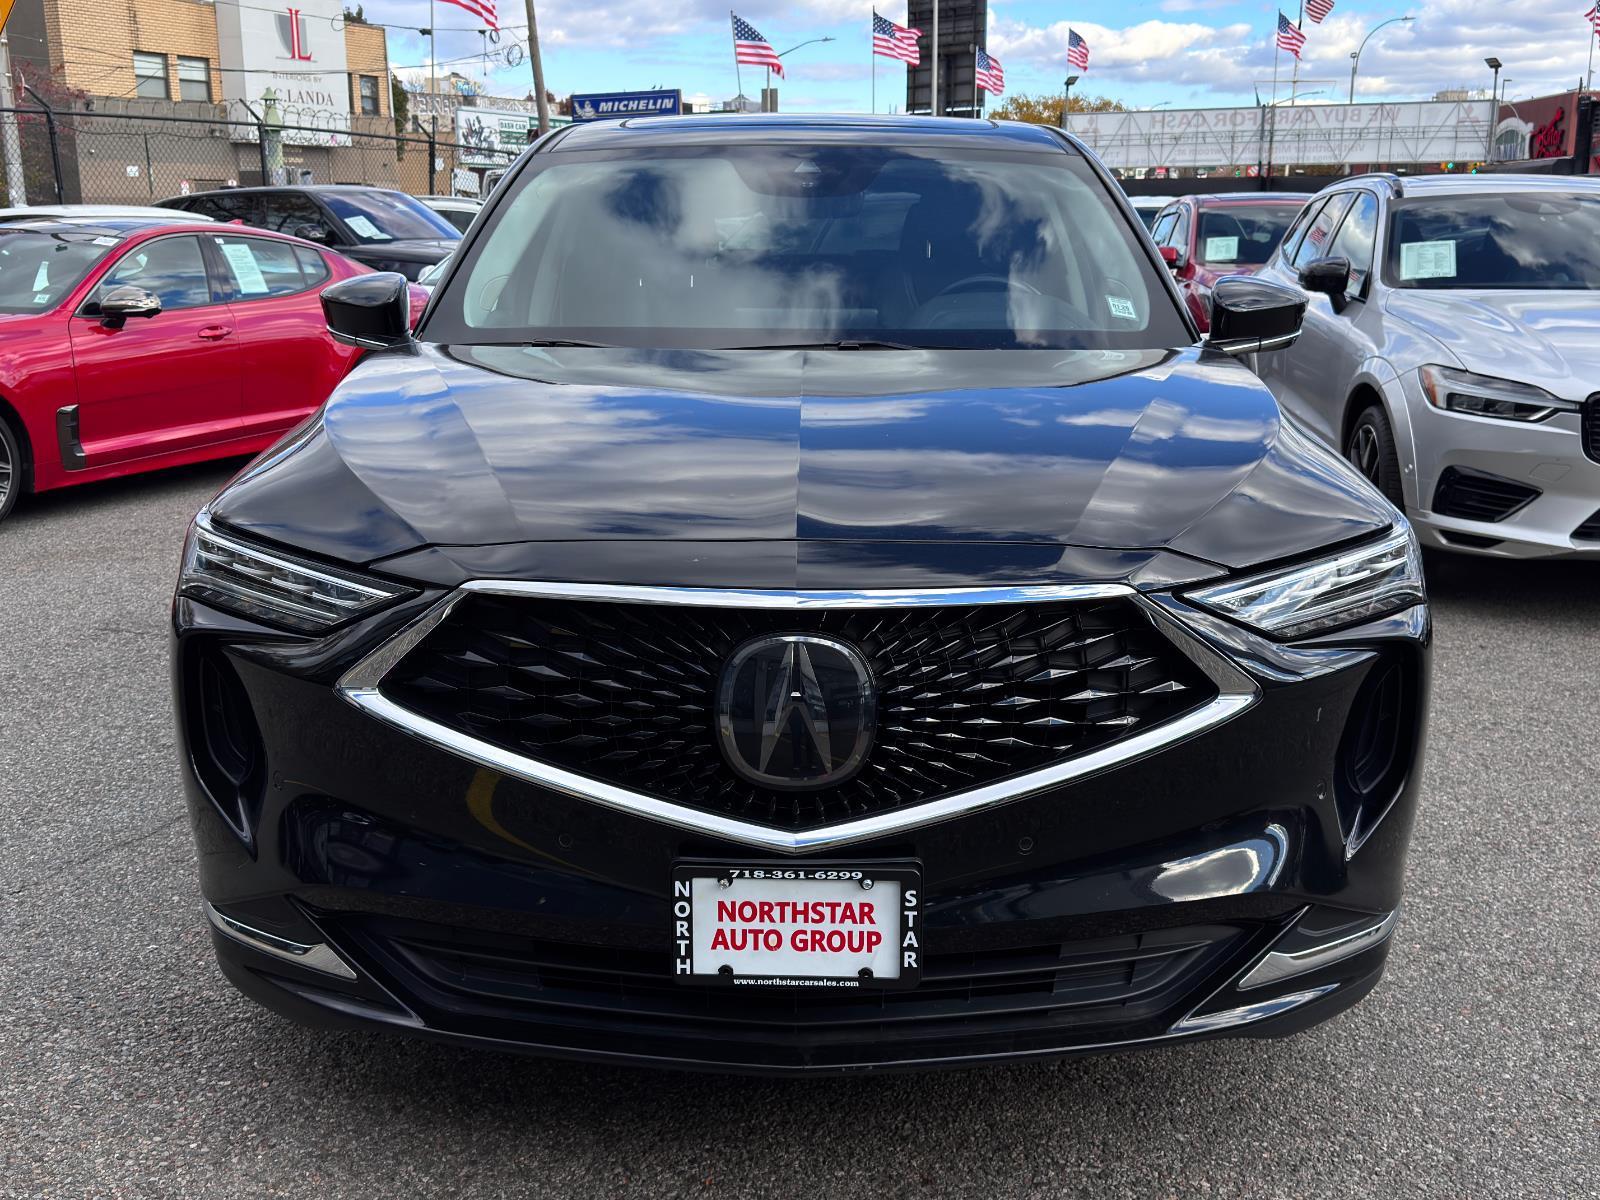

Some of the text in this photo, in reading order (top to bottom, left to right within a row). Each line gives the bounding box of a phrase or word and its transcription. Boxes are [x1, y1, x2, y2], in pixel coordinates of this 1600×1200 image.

[272, 73, 312, 83] INTERIORS
[272, 88, 334, 106] C.LANDA
[598, 98, 674, 113] MICHELIN
[729, 869, 863, 880] 718-361-6299
[717, 900, 876, 925] NORTHSTAR
[674, 880, 692, 975] NORTH
[903, 889, 919, 968] STAR
[711, 928, 882, 953] AUTO GROUP
[733, 977, 859, 988] www.northstarcarsales.com
